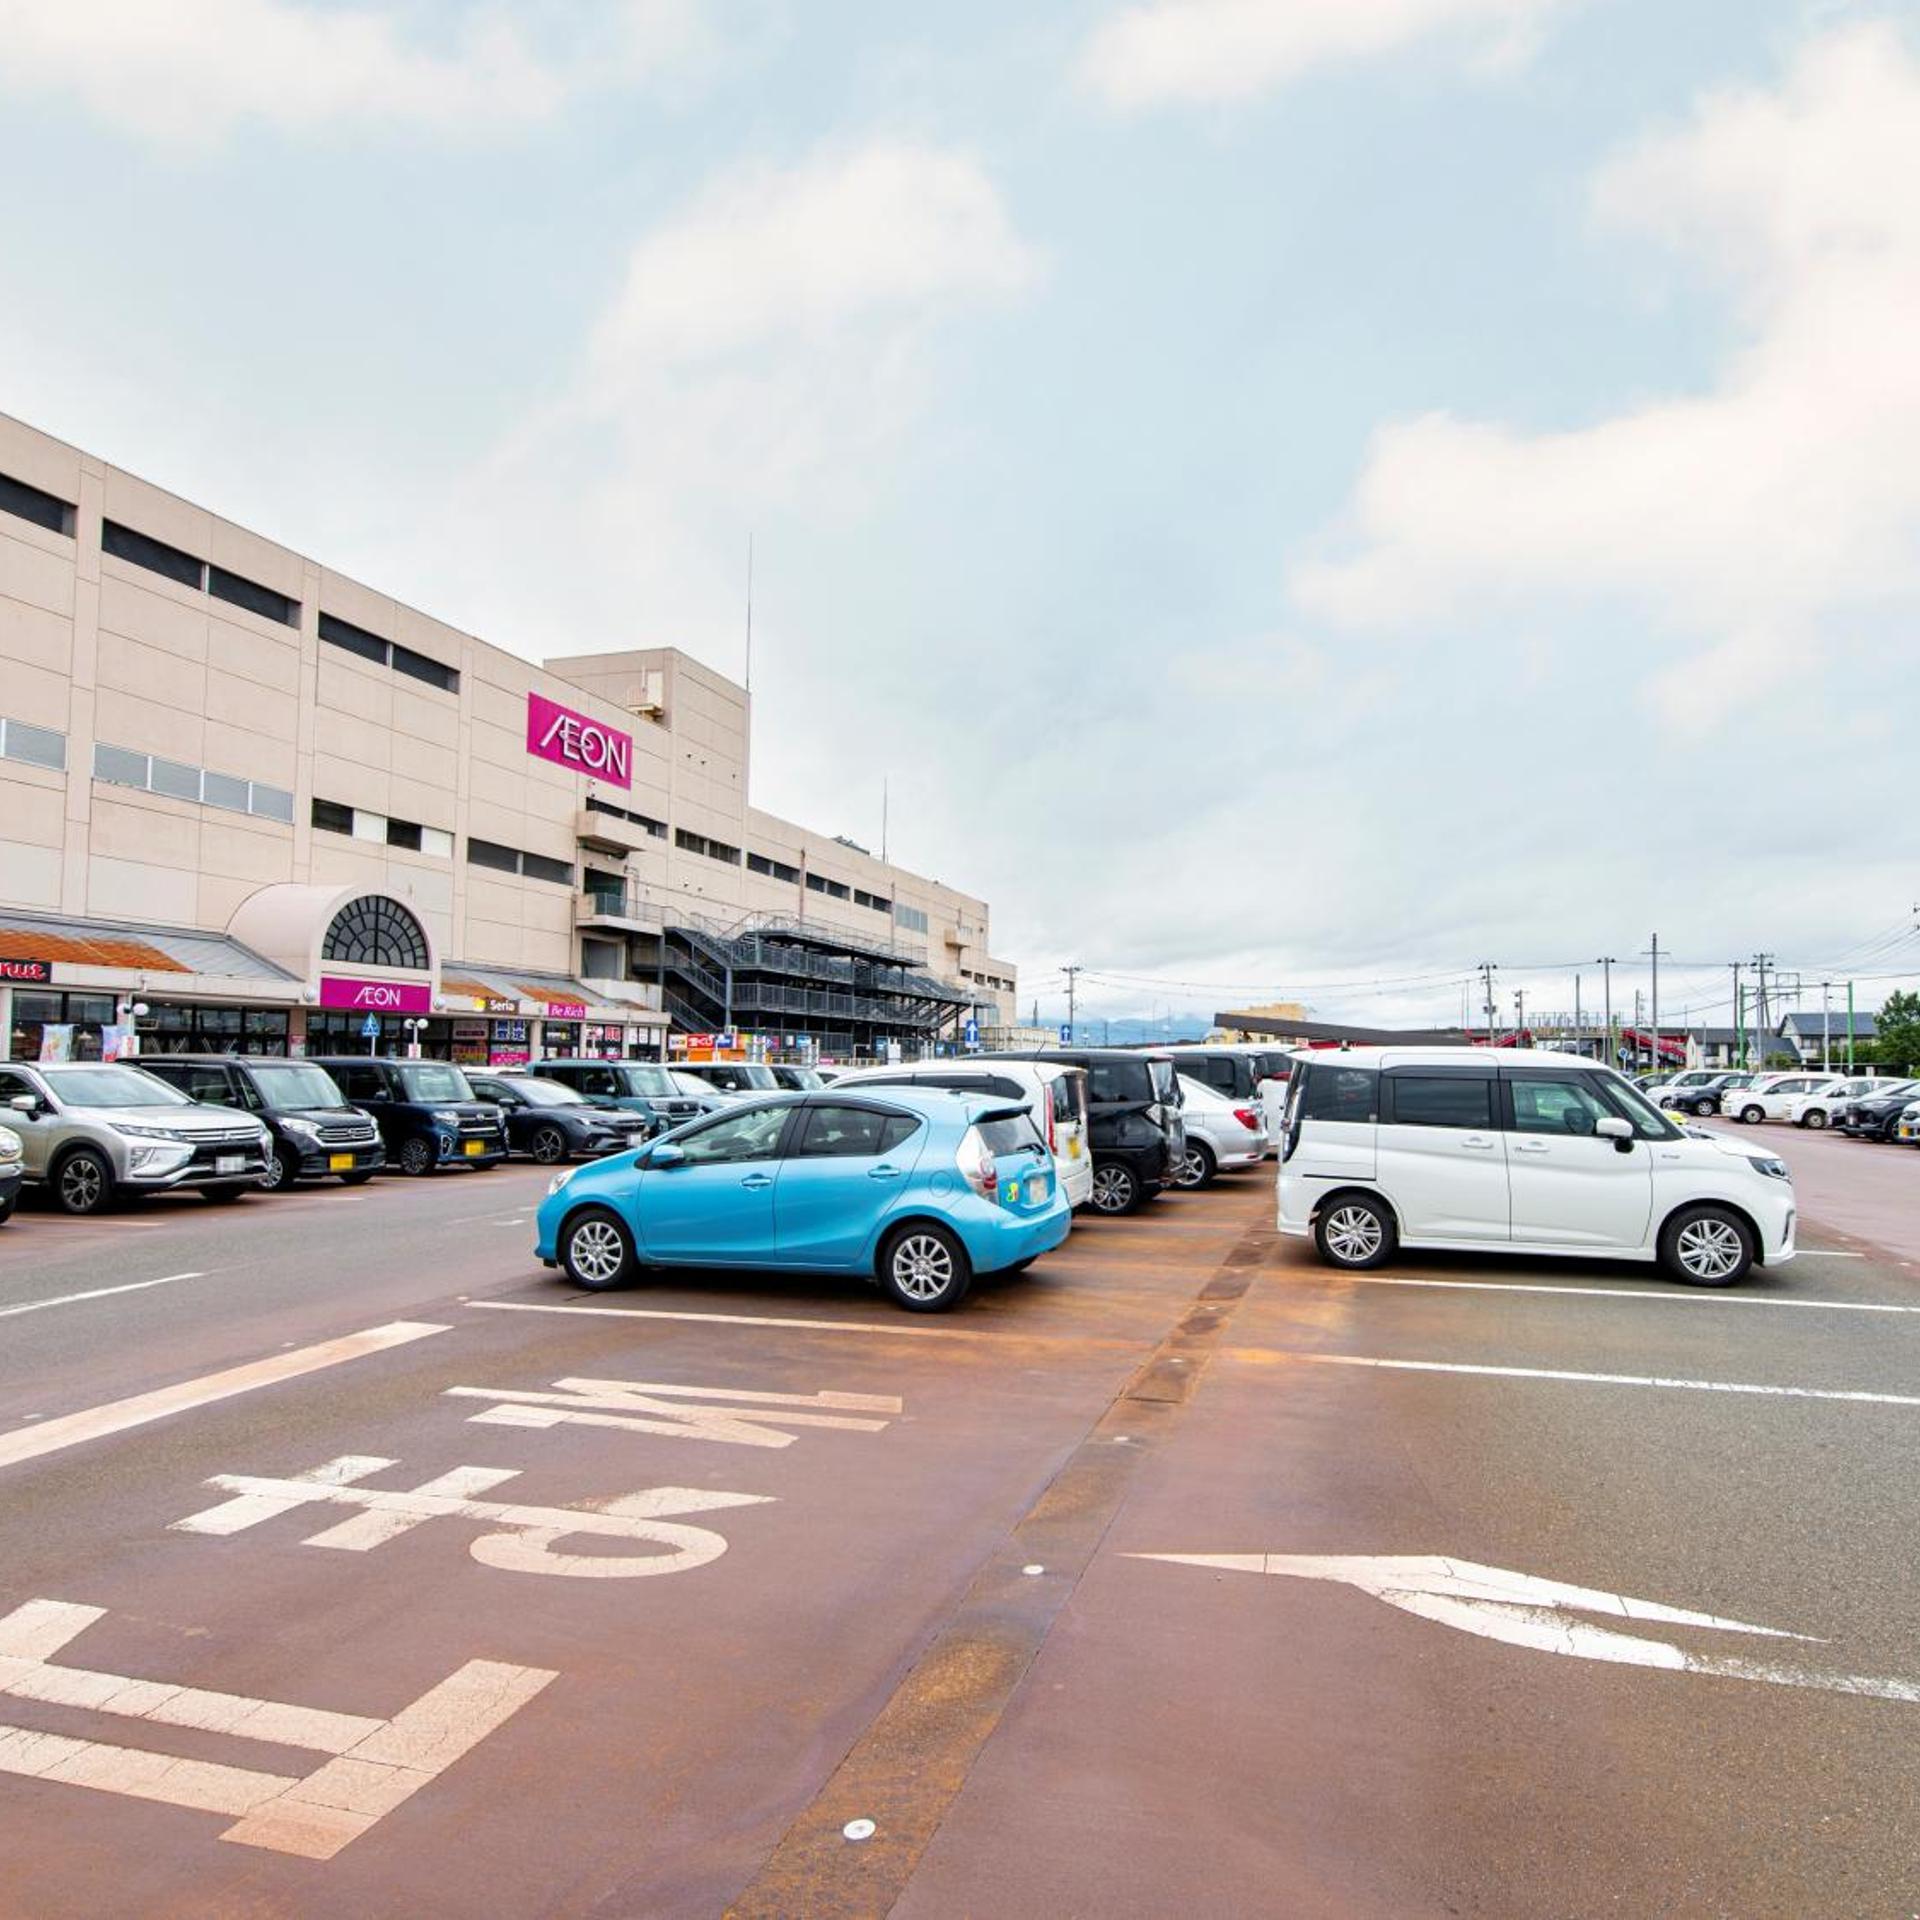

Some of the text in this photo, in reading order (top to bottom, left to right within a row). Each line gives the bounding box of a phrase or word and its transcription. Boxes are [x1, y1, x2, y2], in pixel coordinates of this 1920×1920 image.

[490, 1000, 515, 1011] Seria
[551, 1005, 584, 1017] Be Rich
